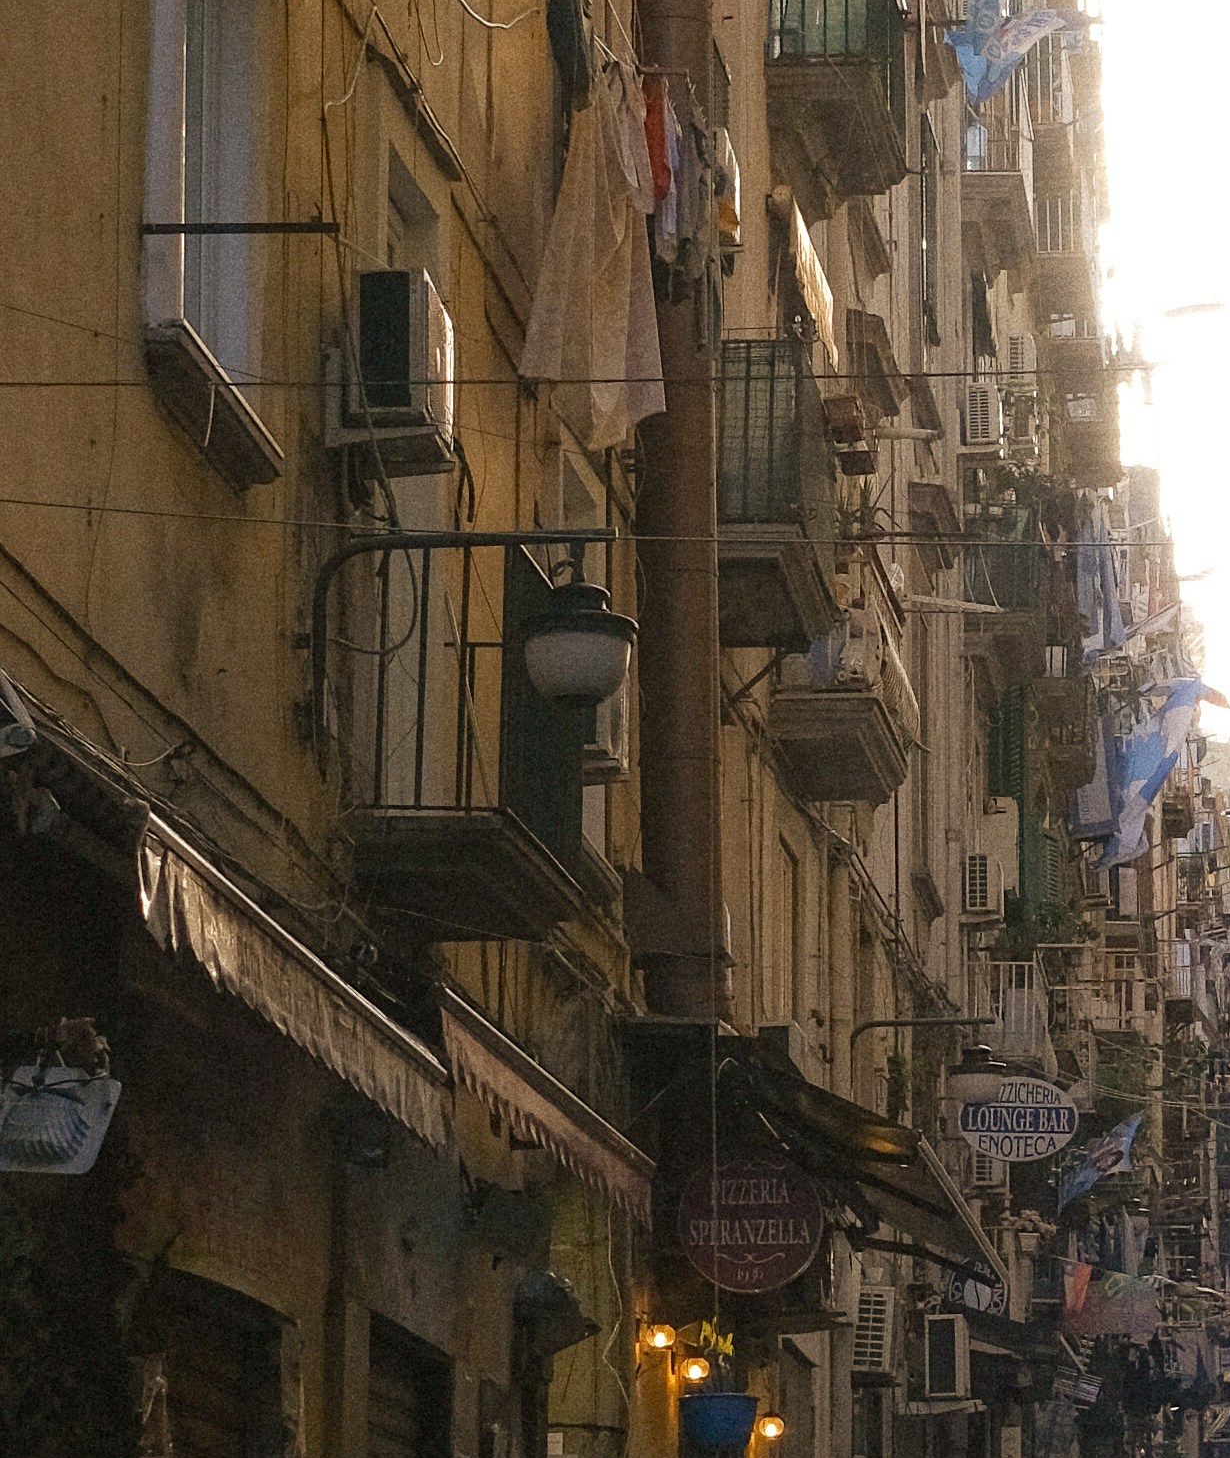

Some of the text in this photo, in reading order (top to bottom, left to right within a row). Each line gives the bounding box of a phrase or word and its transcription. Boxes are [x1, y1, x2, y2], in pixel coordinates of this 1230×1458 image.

[999, 1083, 1061, 1104] ZZICHERIA
[966, 1106, 1070, 1132] LOUNGE BAR
[978, 1135, 1056, 1158] ENOTECA
[689, 1218, 811, 1246] SPERANZELLA
